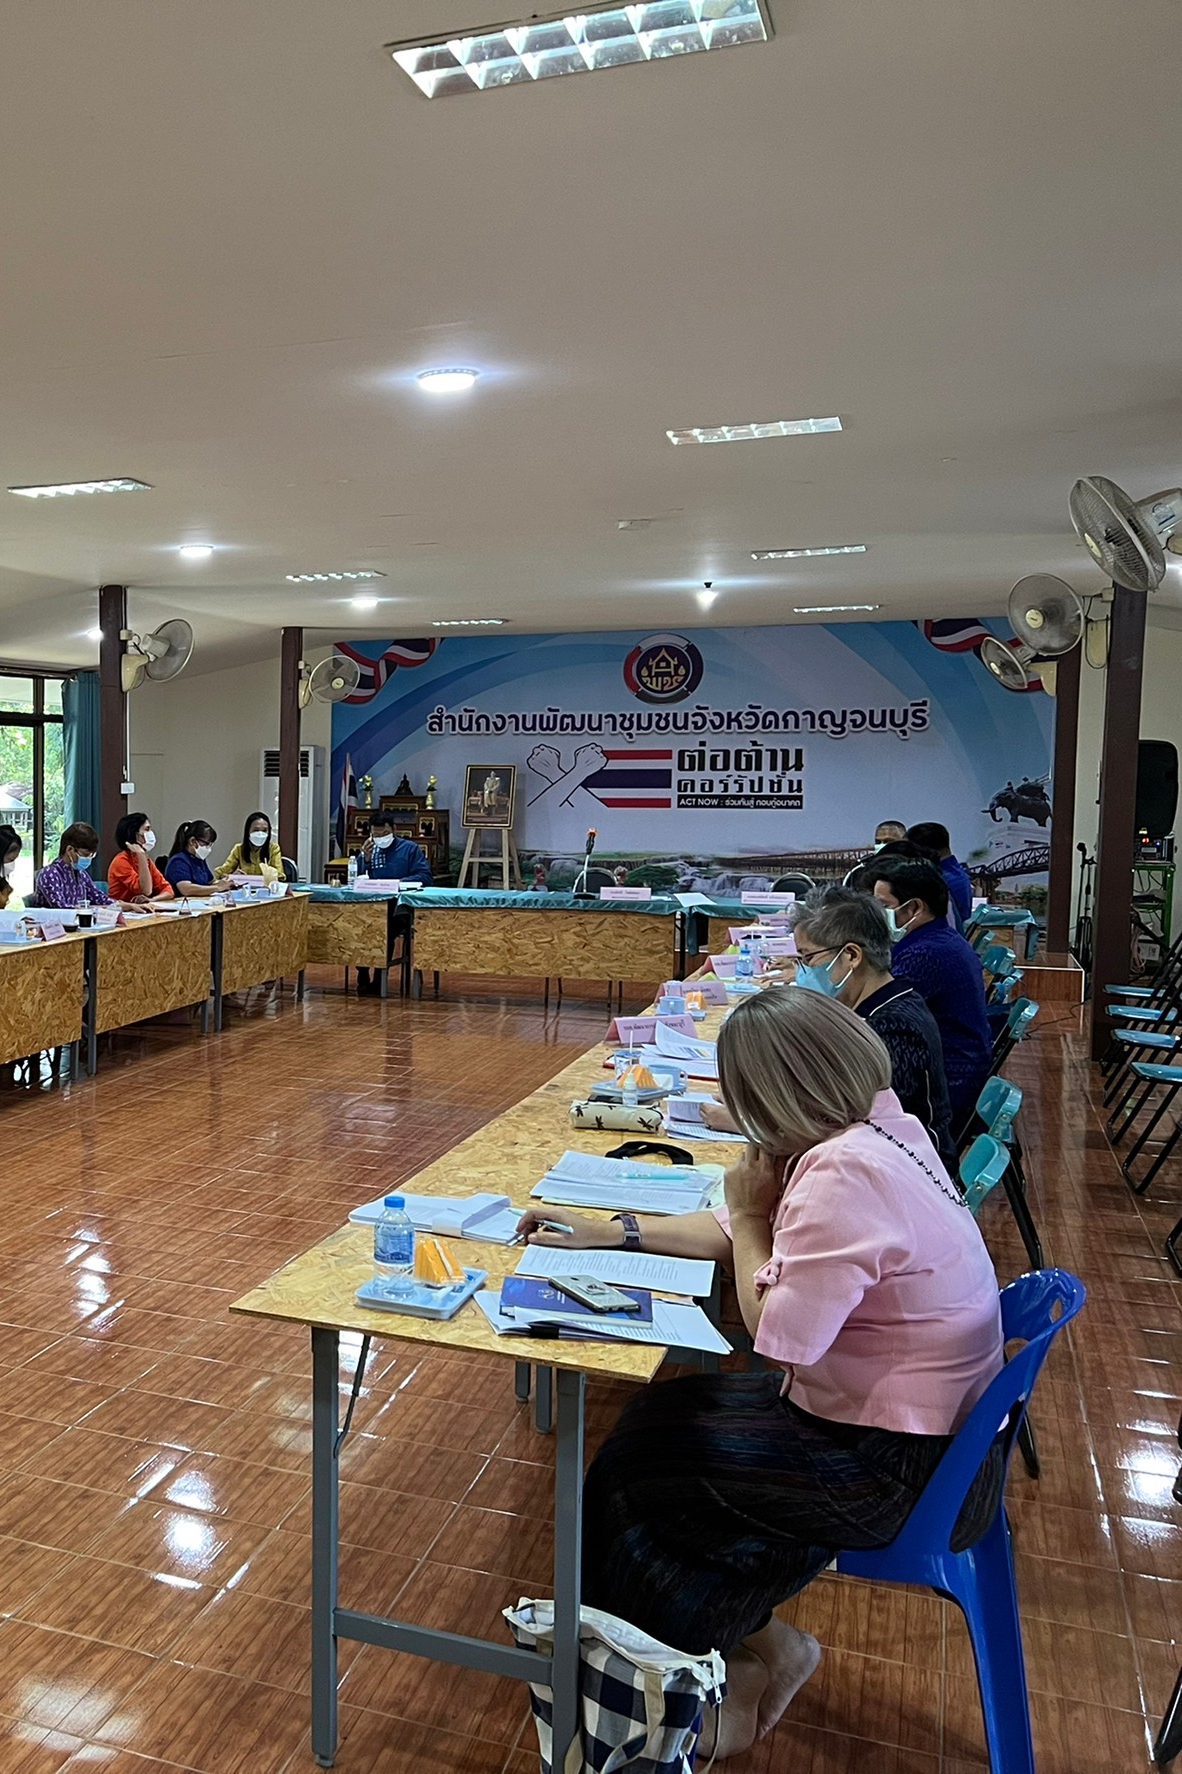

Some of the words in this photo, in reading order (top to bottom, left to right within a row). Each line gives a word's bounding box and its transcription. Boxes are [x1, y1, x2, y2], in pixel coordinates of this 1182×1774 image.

[427, 699, 930, 740] สำนักงานพัฒนาชุมชนจังหวัดกาญจนบุรี
[677, 740, 804, 772] ต่อต้าน
[679, 798, 696, 806] ACT
[697, 798, 719, 806] NOW
